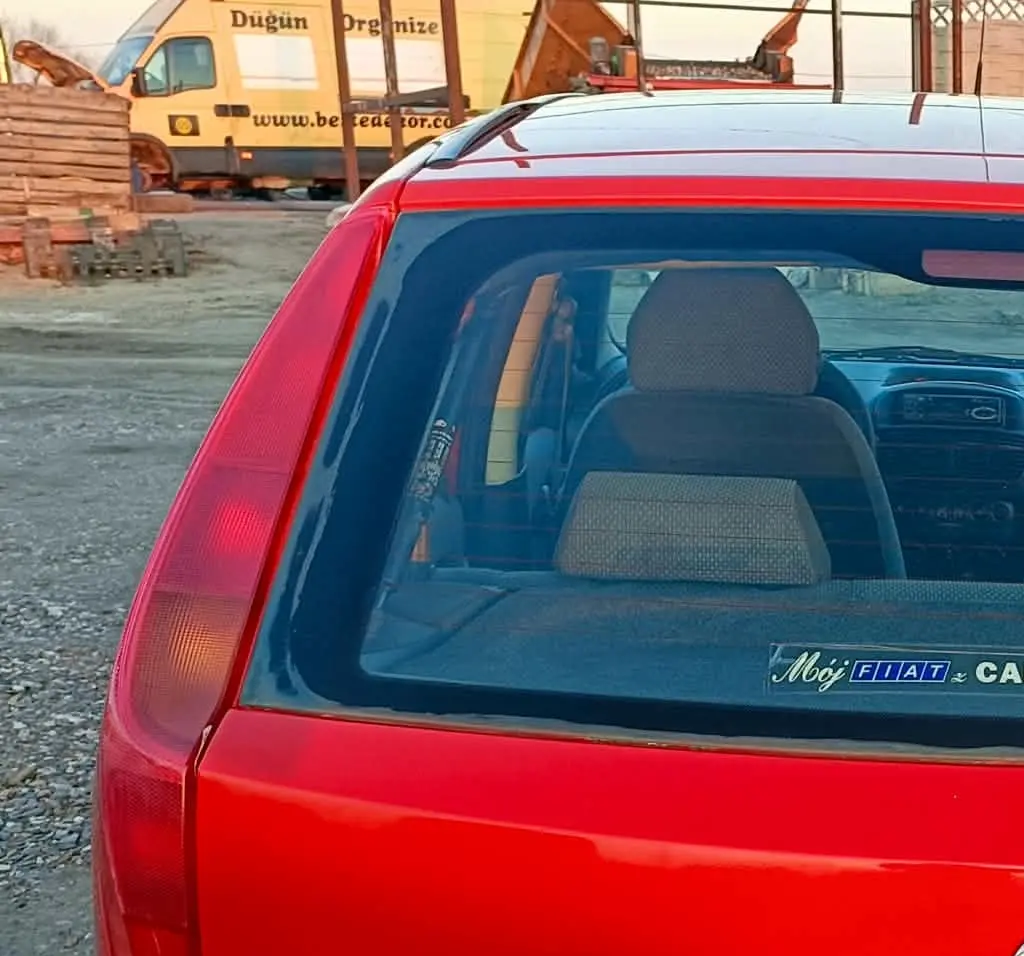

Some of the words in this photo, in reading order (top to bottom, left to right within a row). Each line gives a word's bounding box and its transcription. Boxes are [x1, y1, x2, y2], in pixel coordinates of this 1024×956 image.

[343, 14, 439, 35] Orgnize
[771, 651, 850, 692] Mój
[855, 662, 946, 681] FIAT
